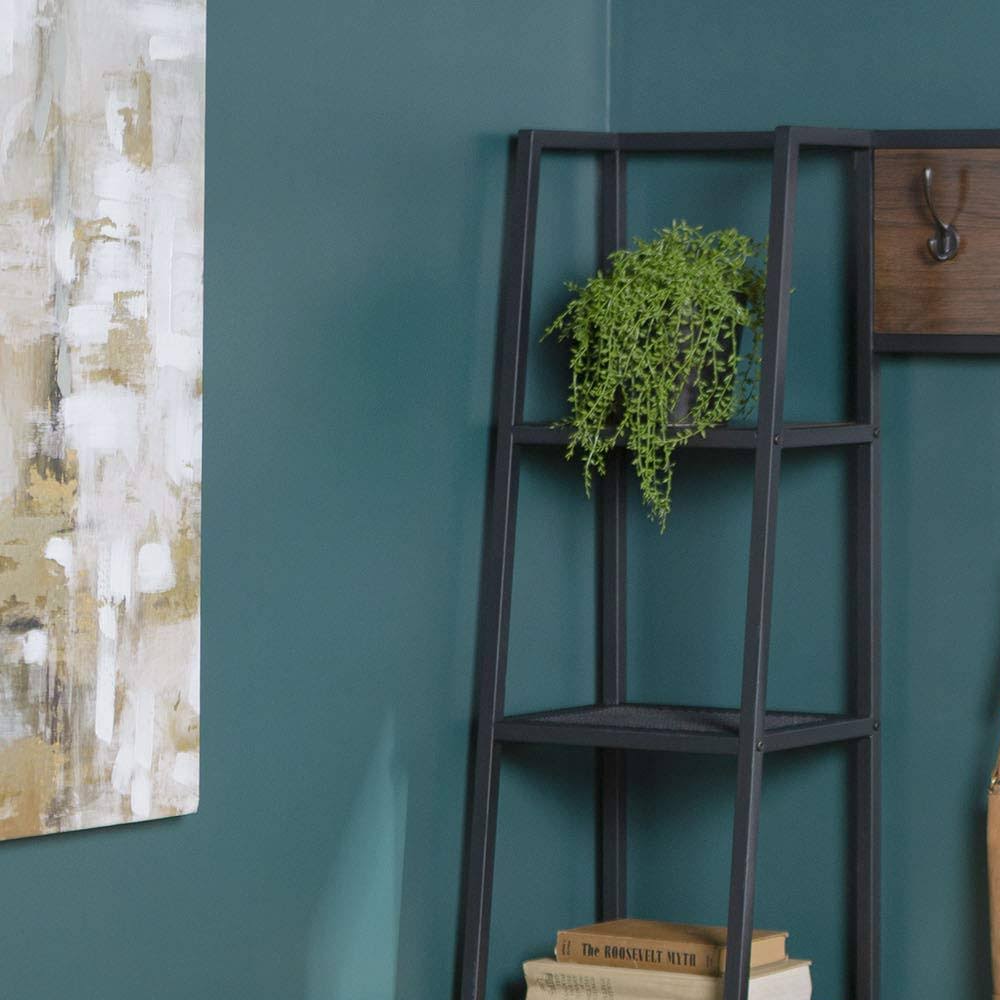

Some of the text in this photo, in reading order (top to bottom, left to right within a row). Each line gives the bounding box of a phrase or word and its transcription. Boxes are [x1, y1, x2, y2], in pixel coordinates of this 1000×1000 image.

[581, 943, 600, 957] The
[604, 945, 663, 963] ROOSEVELT
[667, 951, 696, 967] MYTH
